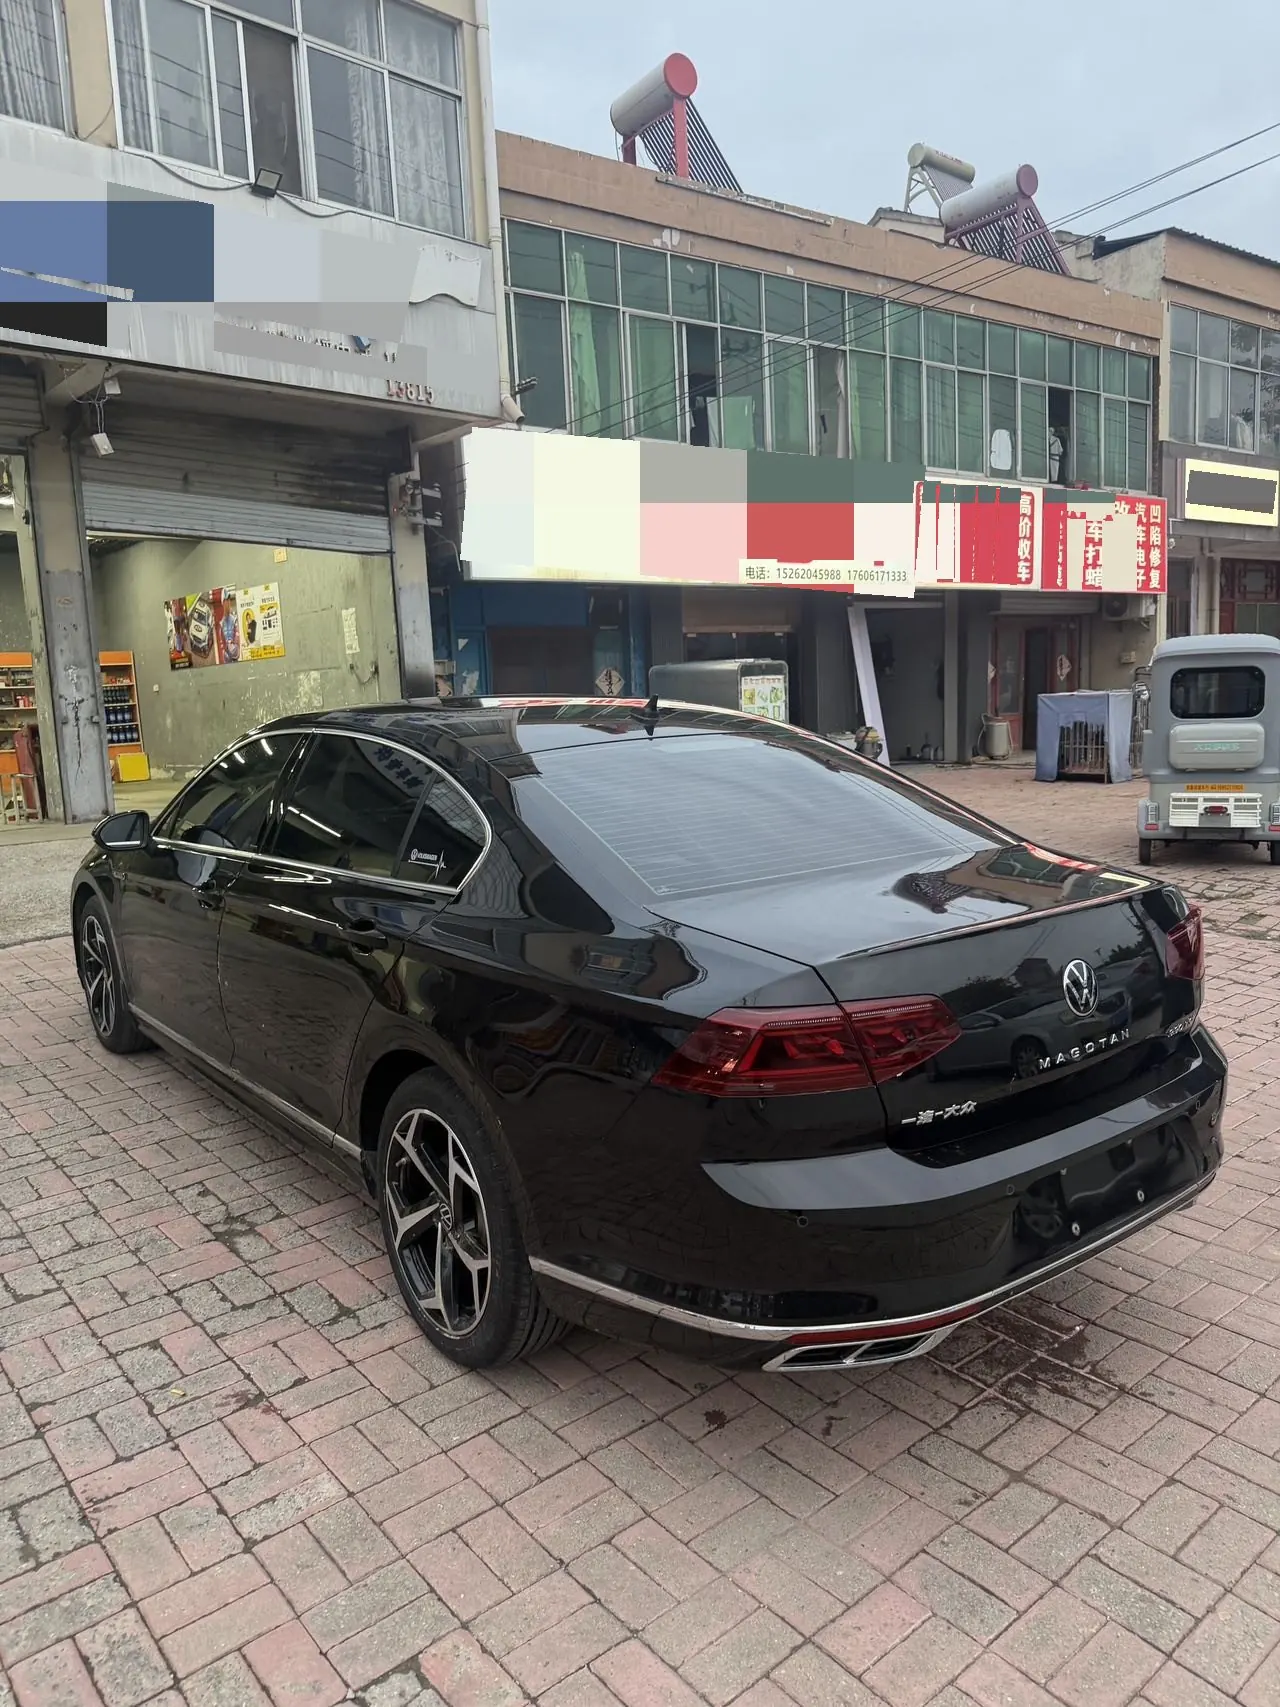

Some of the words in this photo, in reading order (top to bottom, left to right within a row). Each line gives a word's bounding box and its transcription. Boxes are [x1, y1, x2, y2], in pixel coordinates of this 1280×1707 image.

[1149, 504, 1162, 589] 凹陷修复
[776, 568, 842, 581] 15262045988
[847, 570, 908, 582] 17606171333
[1038, 1027, 1131, 1071] MAGOTAN
